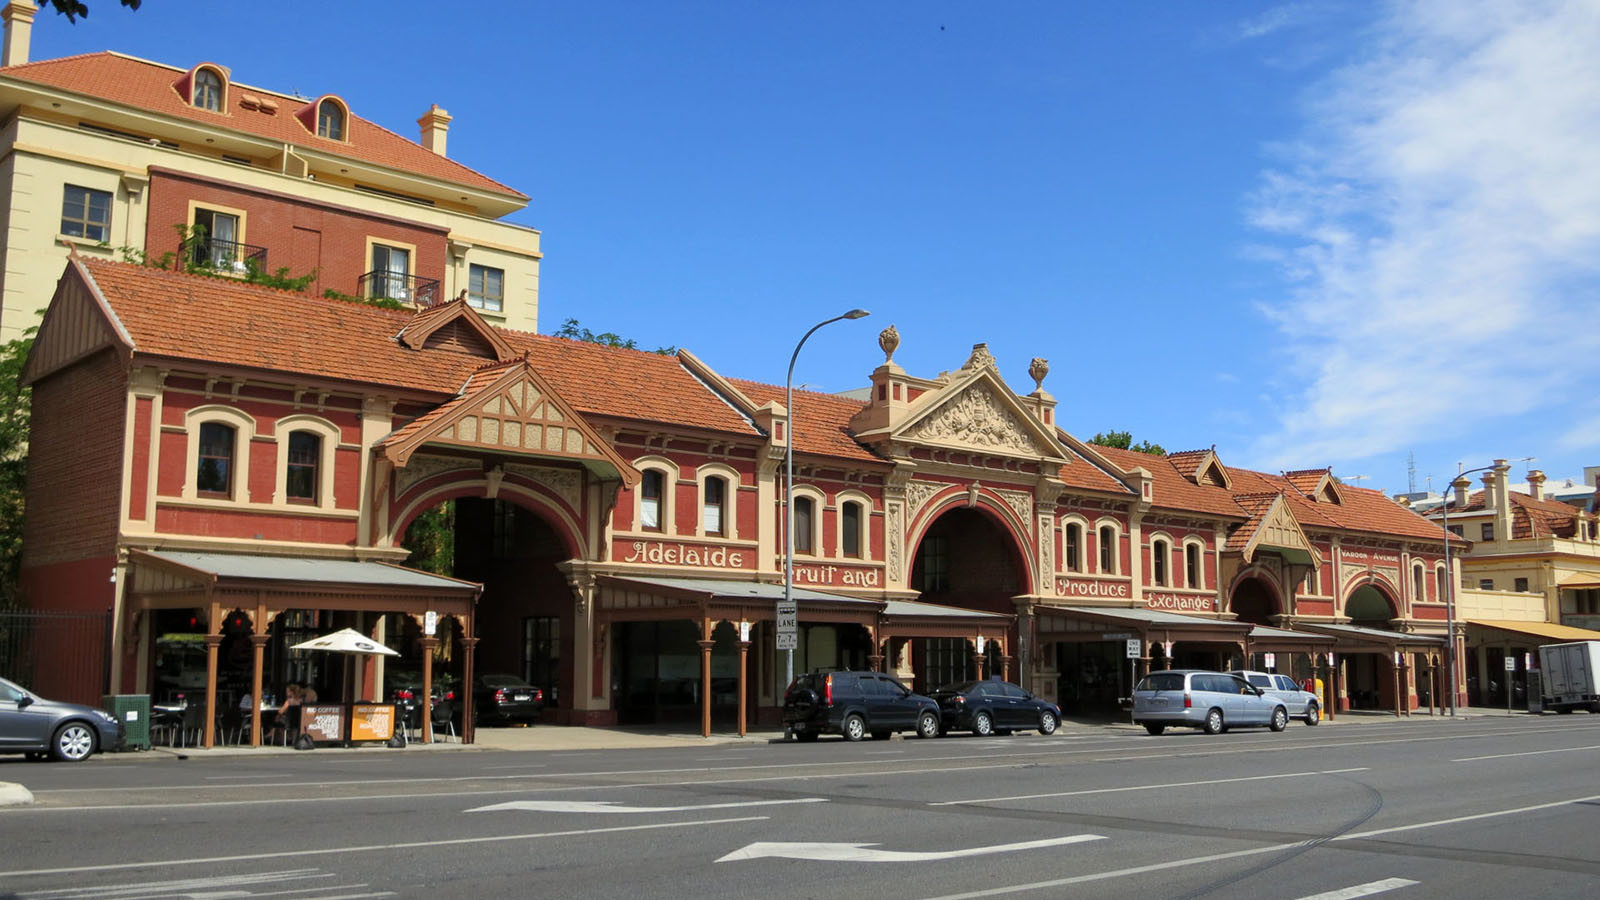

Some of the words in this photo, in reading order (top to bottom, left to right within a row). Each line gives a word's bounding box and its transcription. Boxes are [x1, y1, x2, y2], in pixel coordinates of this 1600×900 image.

[624, 541, 743, 568] Adelaide
[842, 568, 878, 587] and
[1057, 579, 1127, 597] Produce
[1147, 592, 1211, 611] Exchange
[778, 619, 795, 627] LANE
